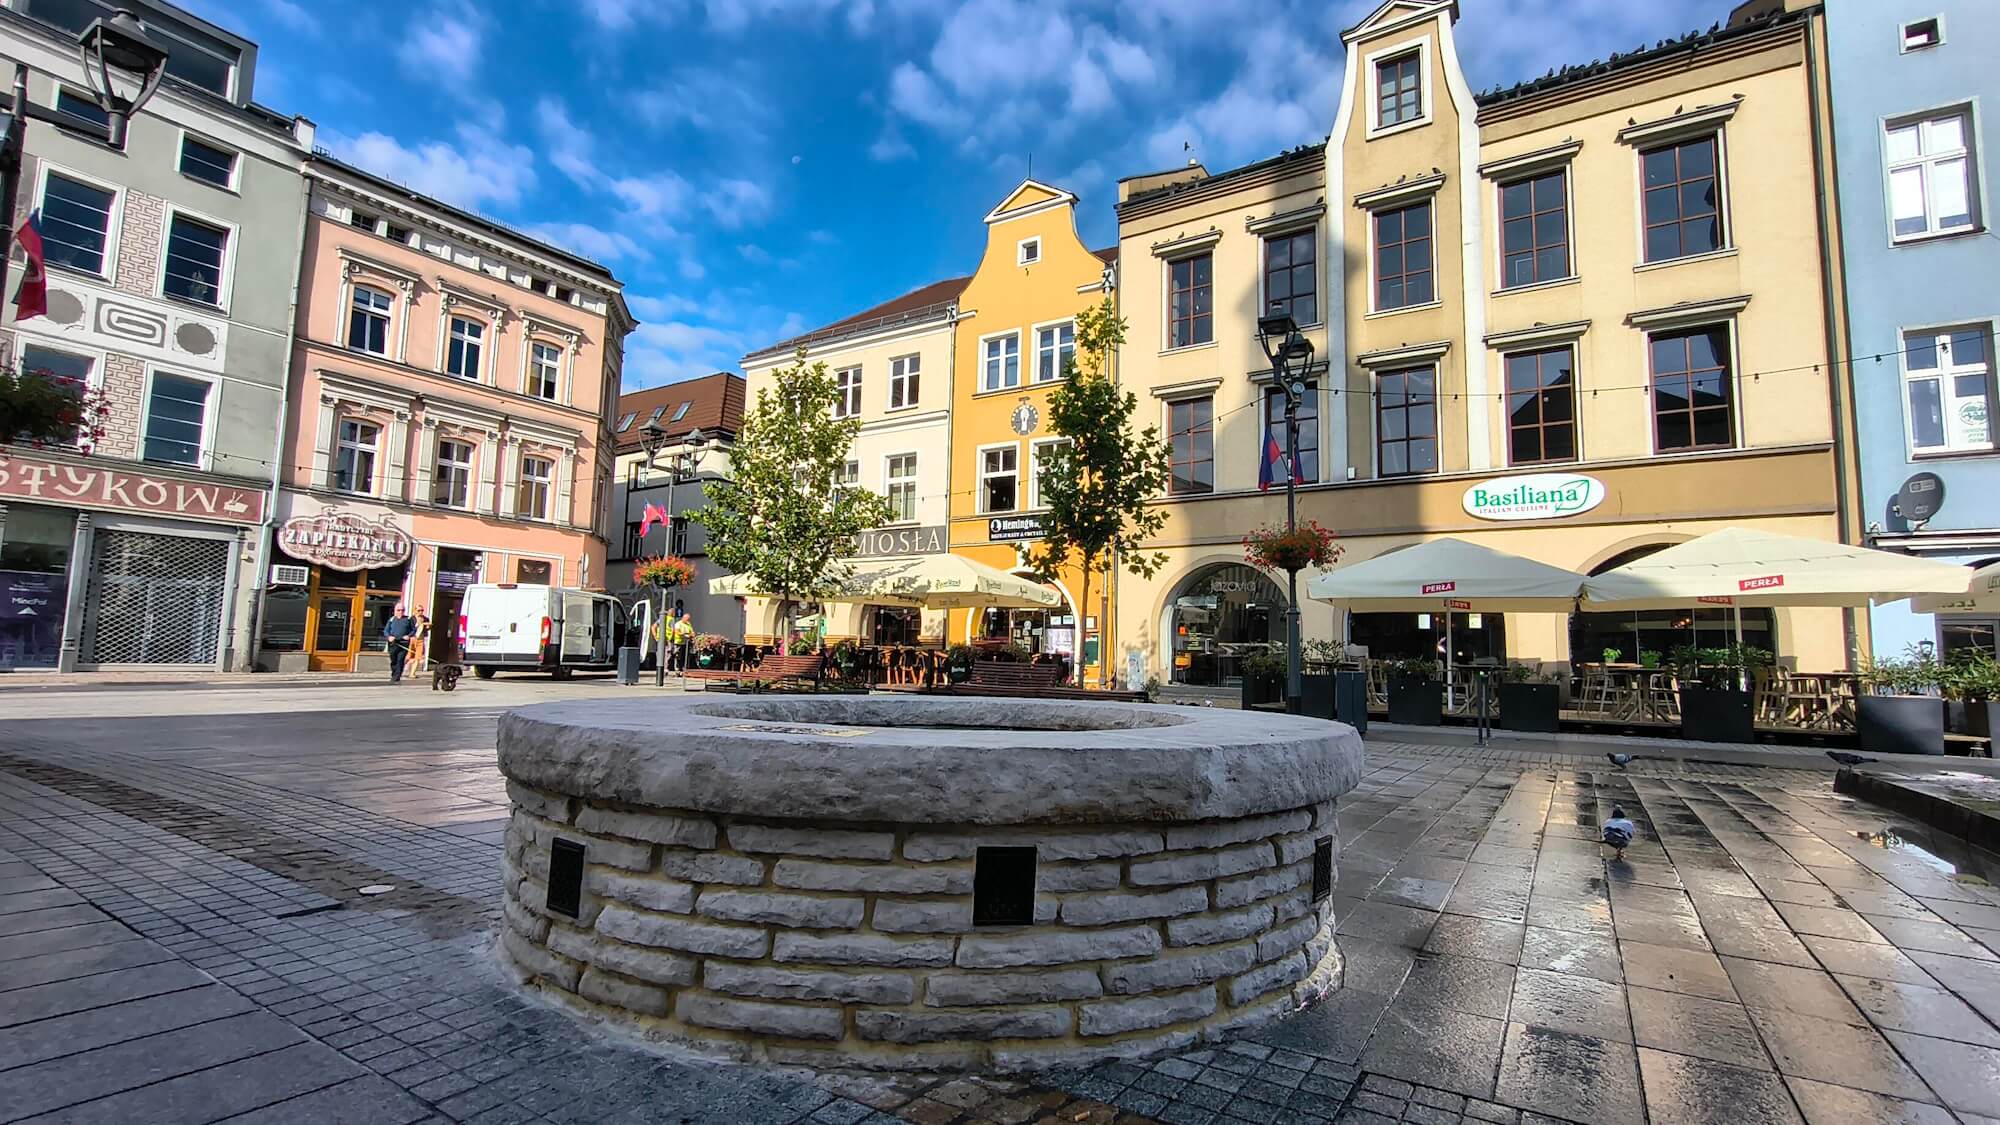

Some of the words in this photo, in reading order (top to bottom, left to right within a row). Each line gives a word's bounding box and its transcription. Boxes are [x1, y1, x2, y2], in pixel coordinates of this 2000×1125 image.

[1474, 485, 1578, 507] Basiliana
[1480, 506, 1511, 514] ITALIAN
[1515, 504, 1549, 512] CUISINE
[287, 529, 404, 554] ZAPIEKANKI
[842, 528, 941, 555] MIOSŁA
[1425, 583, 1452, 593] PERŁA
[1744, 577, 1779, 589] PERŁA
